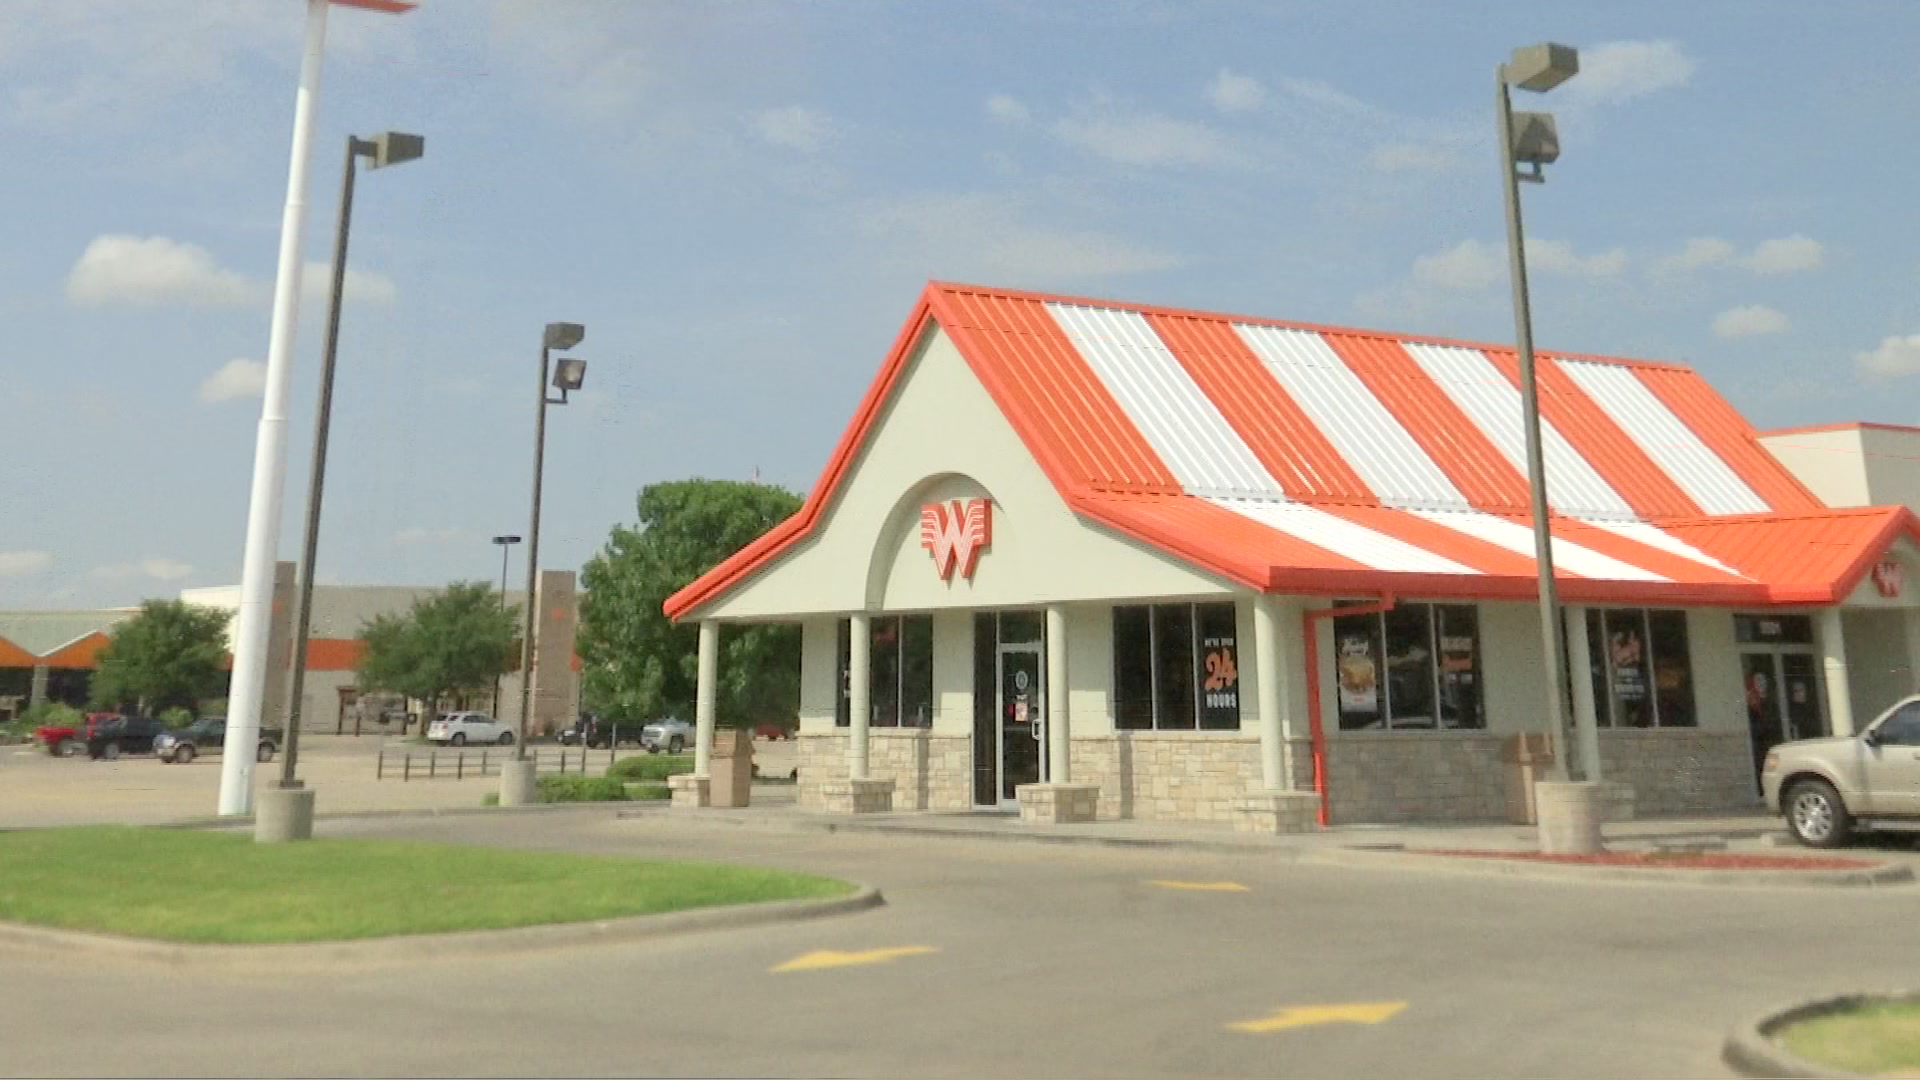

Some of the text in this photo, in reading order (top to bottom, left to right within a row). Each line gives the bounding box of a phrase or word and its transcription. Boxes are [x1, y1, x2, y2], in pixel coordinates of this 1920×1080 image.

[921, 499, 990, 580] W
[1873, 561, 1902, 597] W
[1205, 648, 1237, 690] 24
[1206, 694, 1237, 708] HOURS
